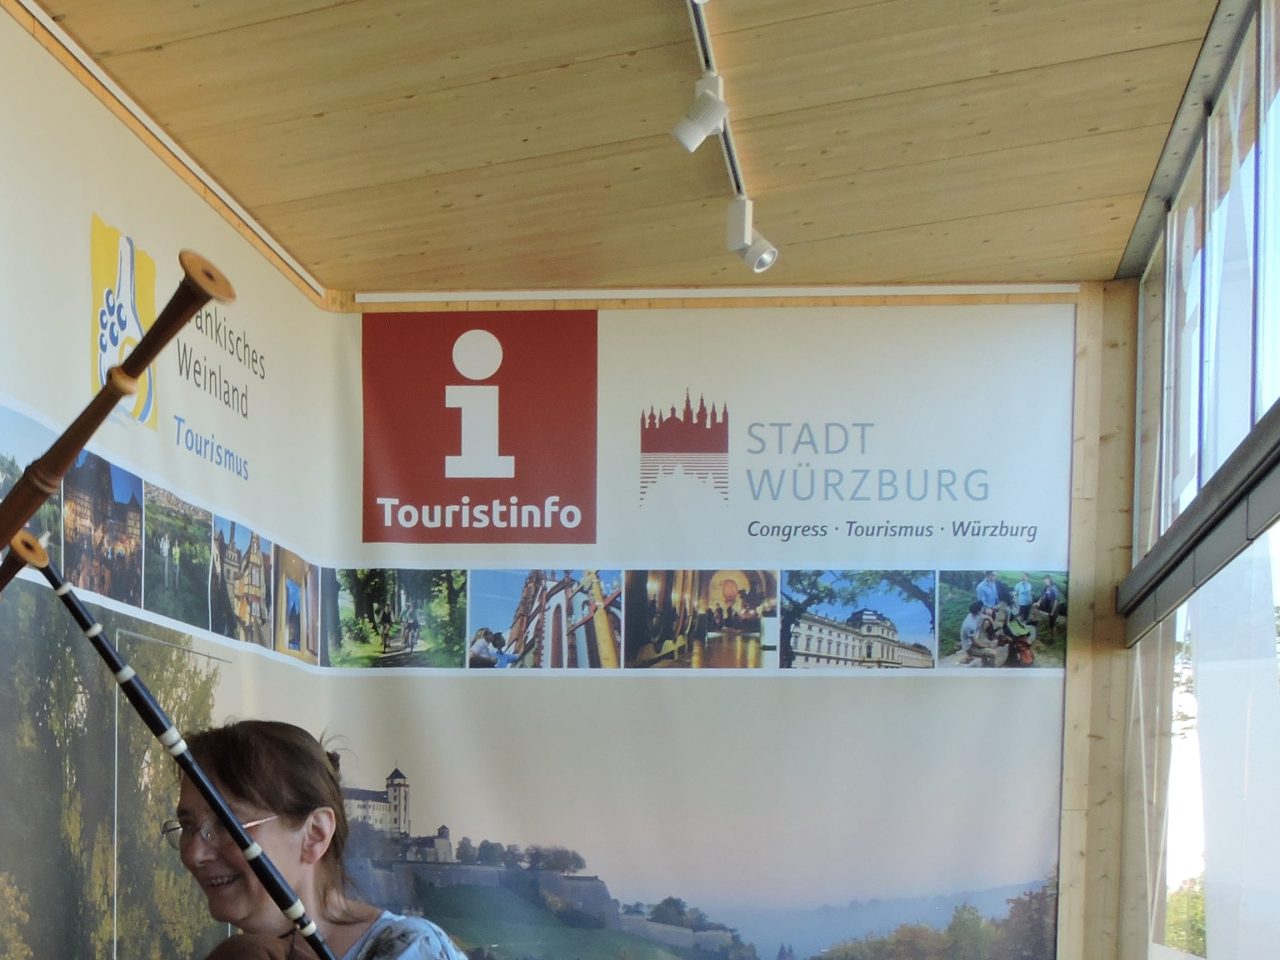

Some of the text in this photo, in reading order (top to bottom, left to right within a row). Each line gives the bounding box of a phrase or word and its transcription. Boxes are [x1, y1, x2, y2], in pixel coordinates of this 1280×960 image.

[176, 337, 249, 420] Weinland
[173, 415, 249, 481] Tourismus
[746, 422, 875, 455] STADT
[746, 462, 990, 502] WÜRZBURG
[376, 495, 582, 529] Touristinfo
[747, 519, 1038, 543] Congress Tourismus Würzburg
